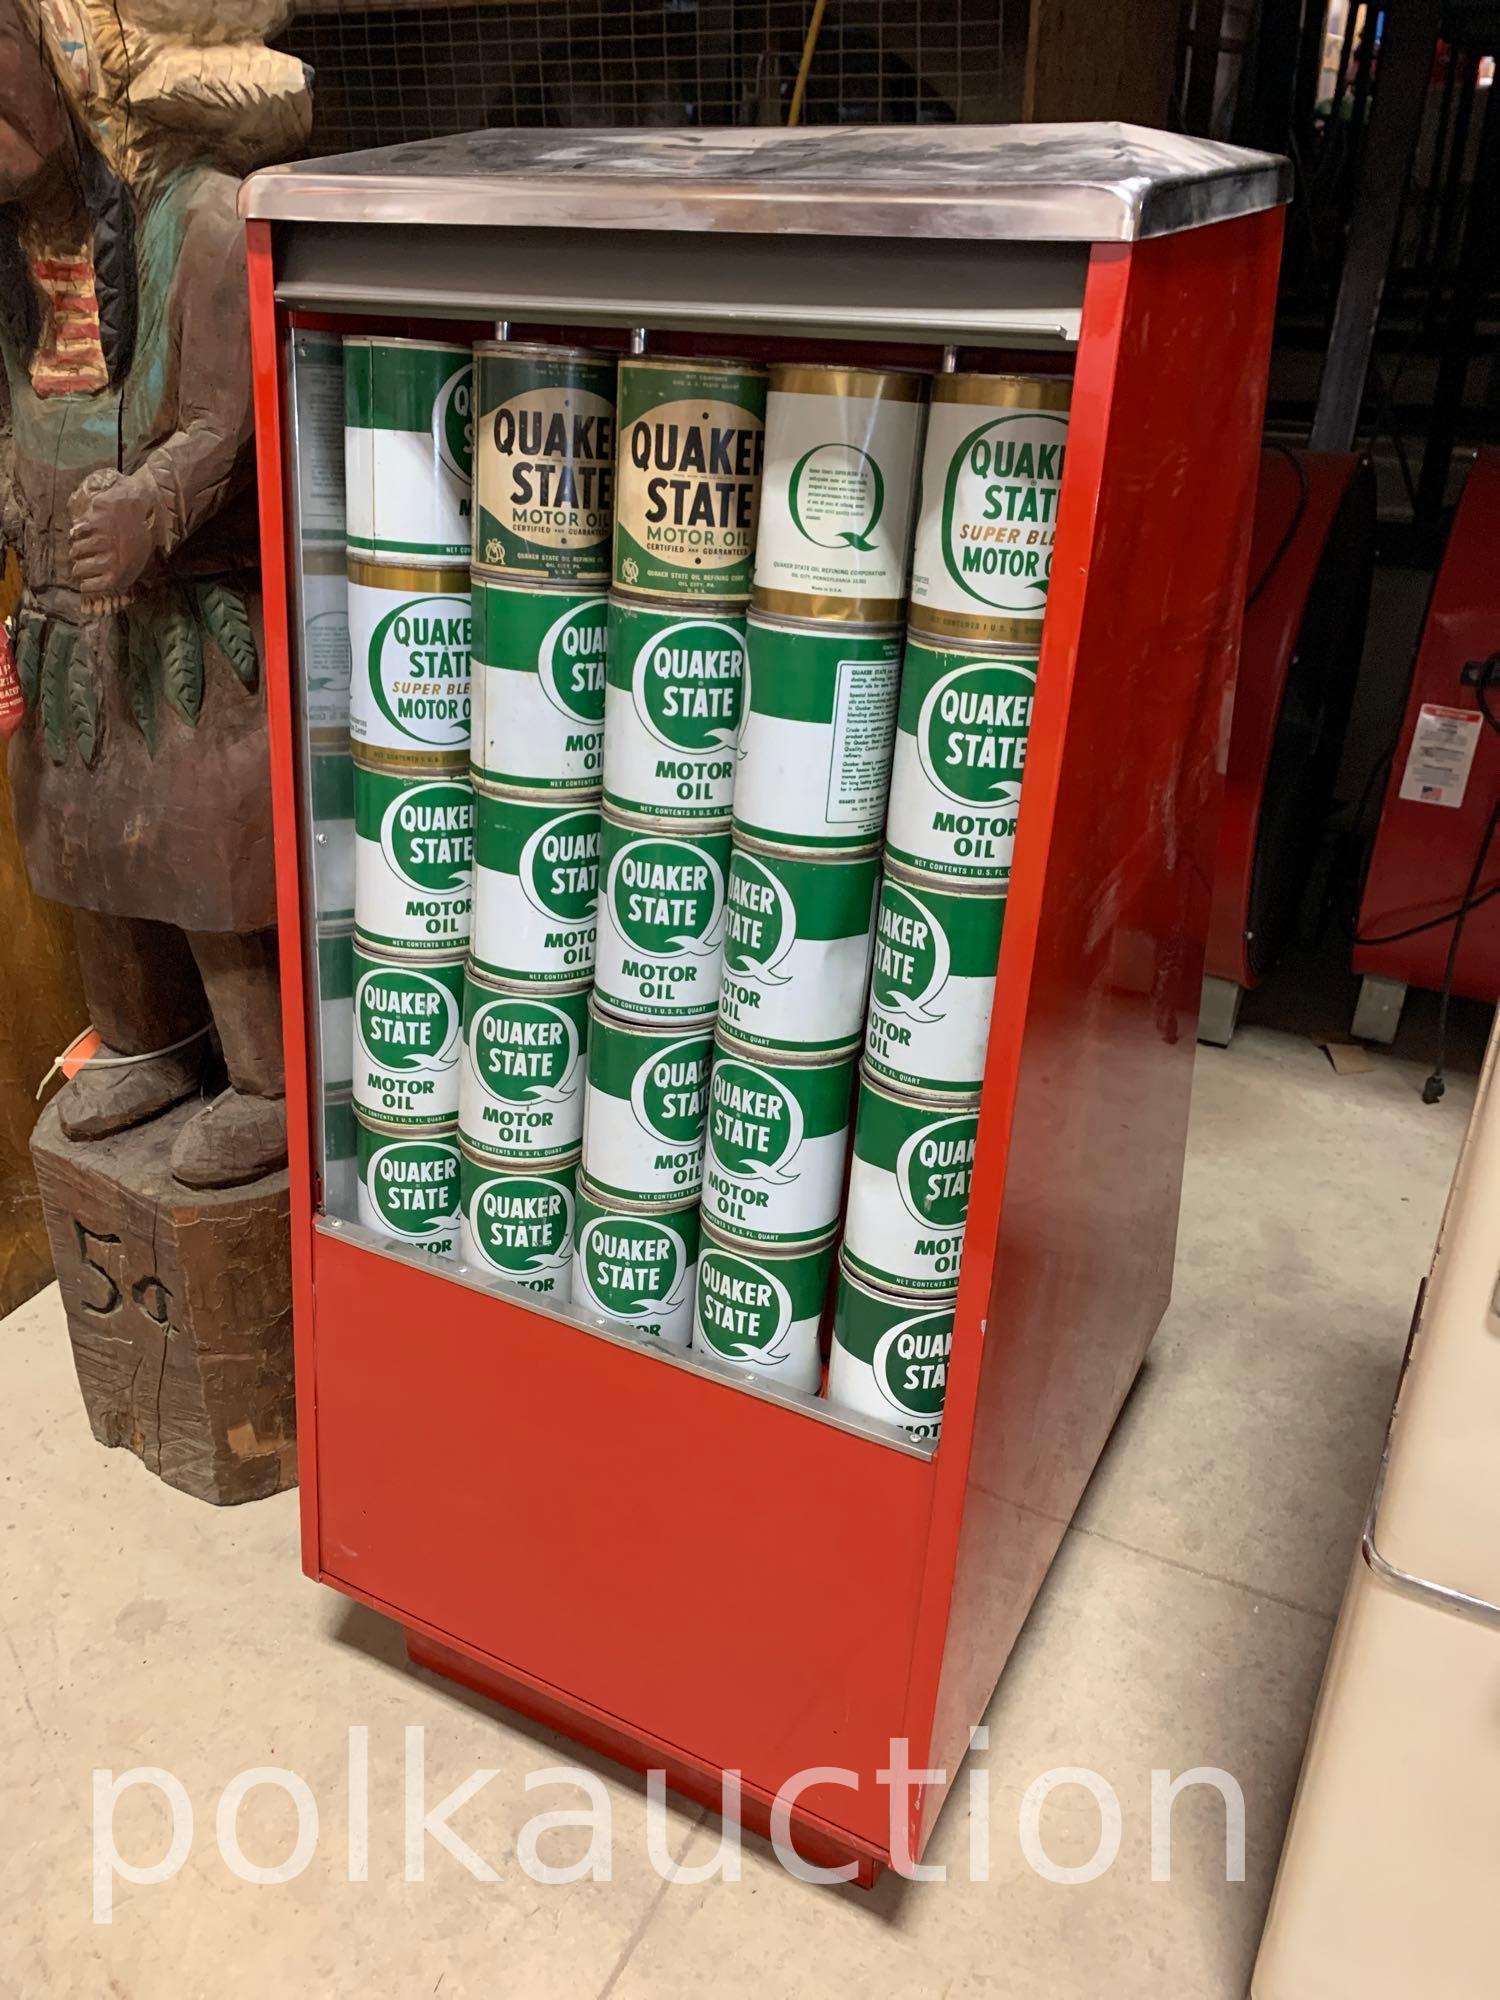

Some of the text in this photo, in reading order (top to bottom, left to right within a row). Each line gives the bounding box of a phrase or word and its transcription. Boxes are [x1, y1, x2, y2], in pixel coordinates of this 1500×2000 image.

[494, 408, 615, 461] QUAKE
[971, 440, 1066, 479] QUAK
[510, 461, 611, 510] STATE
[645, 478, 753, 528] STATE
[513, 508, 578, 527] MOTOR
[513, 524, 550, 534] CERTIFIED
[647, 526, 749, 546] MOTOR OIL
[960, 524, 1056, 546] SUPER BLE
[647, 543, 748, 556] CERTIFIED GUARANTEED
[963, 546, 1040, 577] MOTOR
[394, 616, 471, 647] QUAKE
[562, 626, 608, 657] QUA
[653, 647, 743, 679] QUAKER
[392, 681, 470, 695] SUPER BLE
[571, 662, 606, 692] STA
[398, 698, 458, 720] MOTOR
[662, 687, 734, 718] STATE
[565, 733, 604, 752] MOT
[945, 732, 1027, 769] STATE
[584, 753, 604, 770] OI
[655, 760, 732, 780] MOTOR
[551, 779, 562, 787] NET
[676, 783, 713, 800] OIL
[640, 805, 652, 813] NET
[655, 808, 690, 816] CONTENTS
[409, 837, 472, 864] STATE
[542, 832, 600, 861] QUAK
[954, 838, 995, 858] OIL
[622, 858, 708, 891] QUAKER
[915, 859, 1005, 877] NET CONTENTS U.S. FL.
[550, 868, 598, 894] STAT
[729, 873, 775, 915] UAKER
[628, 893, 697, 926] STATE
[425, 919, 458, 934] OIL
[544, 928, 596, 947] MOTO
[726, 906, 763, 948] TATE
[564, 946, 592, 964] OIL
[874, 938, 914, 984] TATE
[622, 960, 698, 981] MOTOR
[364, 984, 441, 1015] QUAKER
[639, 982, 675, 1000] OIL
[721, 974, 761, 1008] OTOR
[621, 1000, 652, 1013] CONTENTS
[687, 1005, 706, 1014] QUART
[722, 997, 740, 1021] OIL
[370, 1016, 431, 1045] STATE
[482, 1015, 563, 1046] QUAKER
[870, 1010, 911, 1046] OTOR
[750, 1036, 770, 1045] QUART
[870, 1031, 889, 1058] OIL
[488, 1048, 553, 1077] STATE
[368, 1073, 435, 1094] MOTOR
[900, 1074, 920, 1085] QUART
[382, 1094, 414, 1110] OIL
[713, 1074, 783, 1121] QUAKER
[368, 1109, 393, 1122] CONTENTS
[427, 1115, 445, 1123] QUART
[482, 1106, 554, 1127] MOTOR
[498, 1128, 532, 1144] OIL
[714, 1109, 770, 1152] STATE
[482, 1142, 511, 1155] CONTENTS
[533, 1149, 543, 1157] FL.
[544, 1147, 562, 1157] QUART
[654, 1149, 703, 1170] MOTO
[380, 1158, 456, 1182] QUAKER
[388, 1186, 449, 1211] STATE
[654, 1191, 684, 1200] CONTENTS
[708, 1171, 769, 1208] MOTOR
[483, 1194, 562, 1218] QUAKER
[717, 1197, 746, 1221] OIL
[490, 1223, 552, 1248] STATE
[731, 1226, 745, 1236] U.S.
[747, 1230, 755, 1238] FL.
[757, 1233, 779, 1241] QUART
[408, 1239, 452, 1254] TOR
[592, 1230, 670, 1262] QUAKER
[914, 1236, 964, 1256] MOT
[597, 1261, 660, 1291] STATE
[934, 1257, 961, 1273] OI
[514, 1278, 555, 1292] TOR
[702, 1261, 772, 1308] QUAKER
[896, 1278, 909, 1286] NET
[704, 1295, 761, 1337] STATE
[903, 1363, 949, 1390] STA
